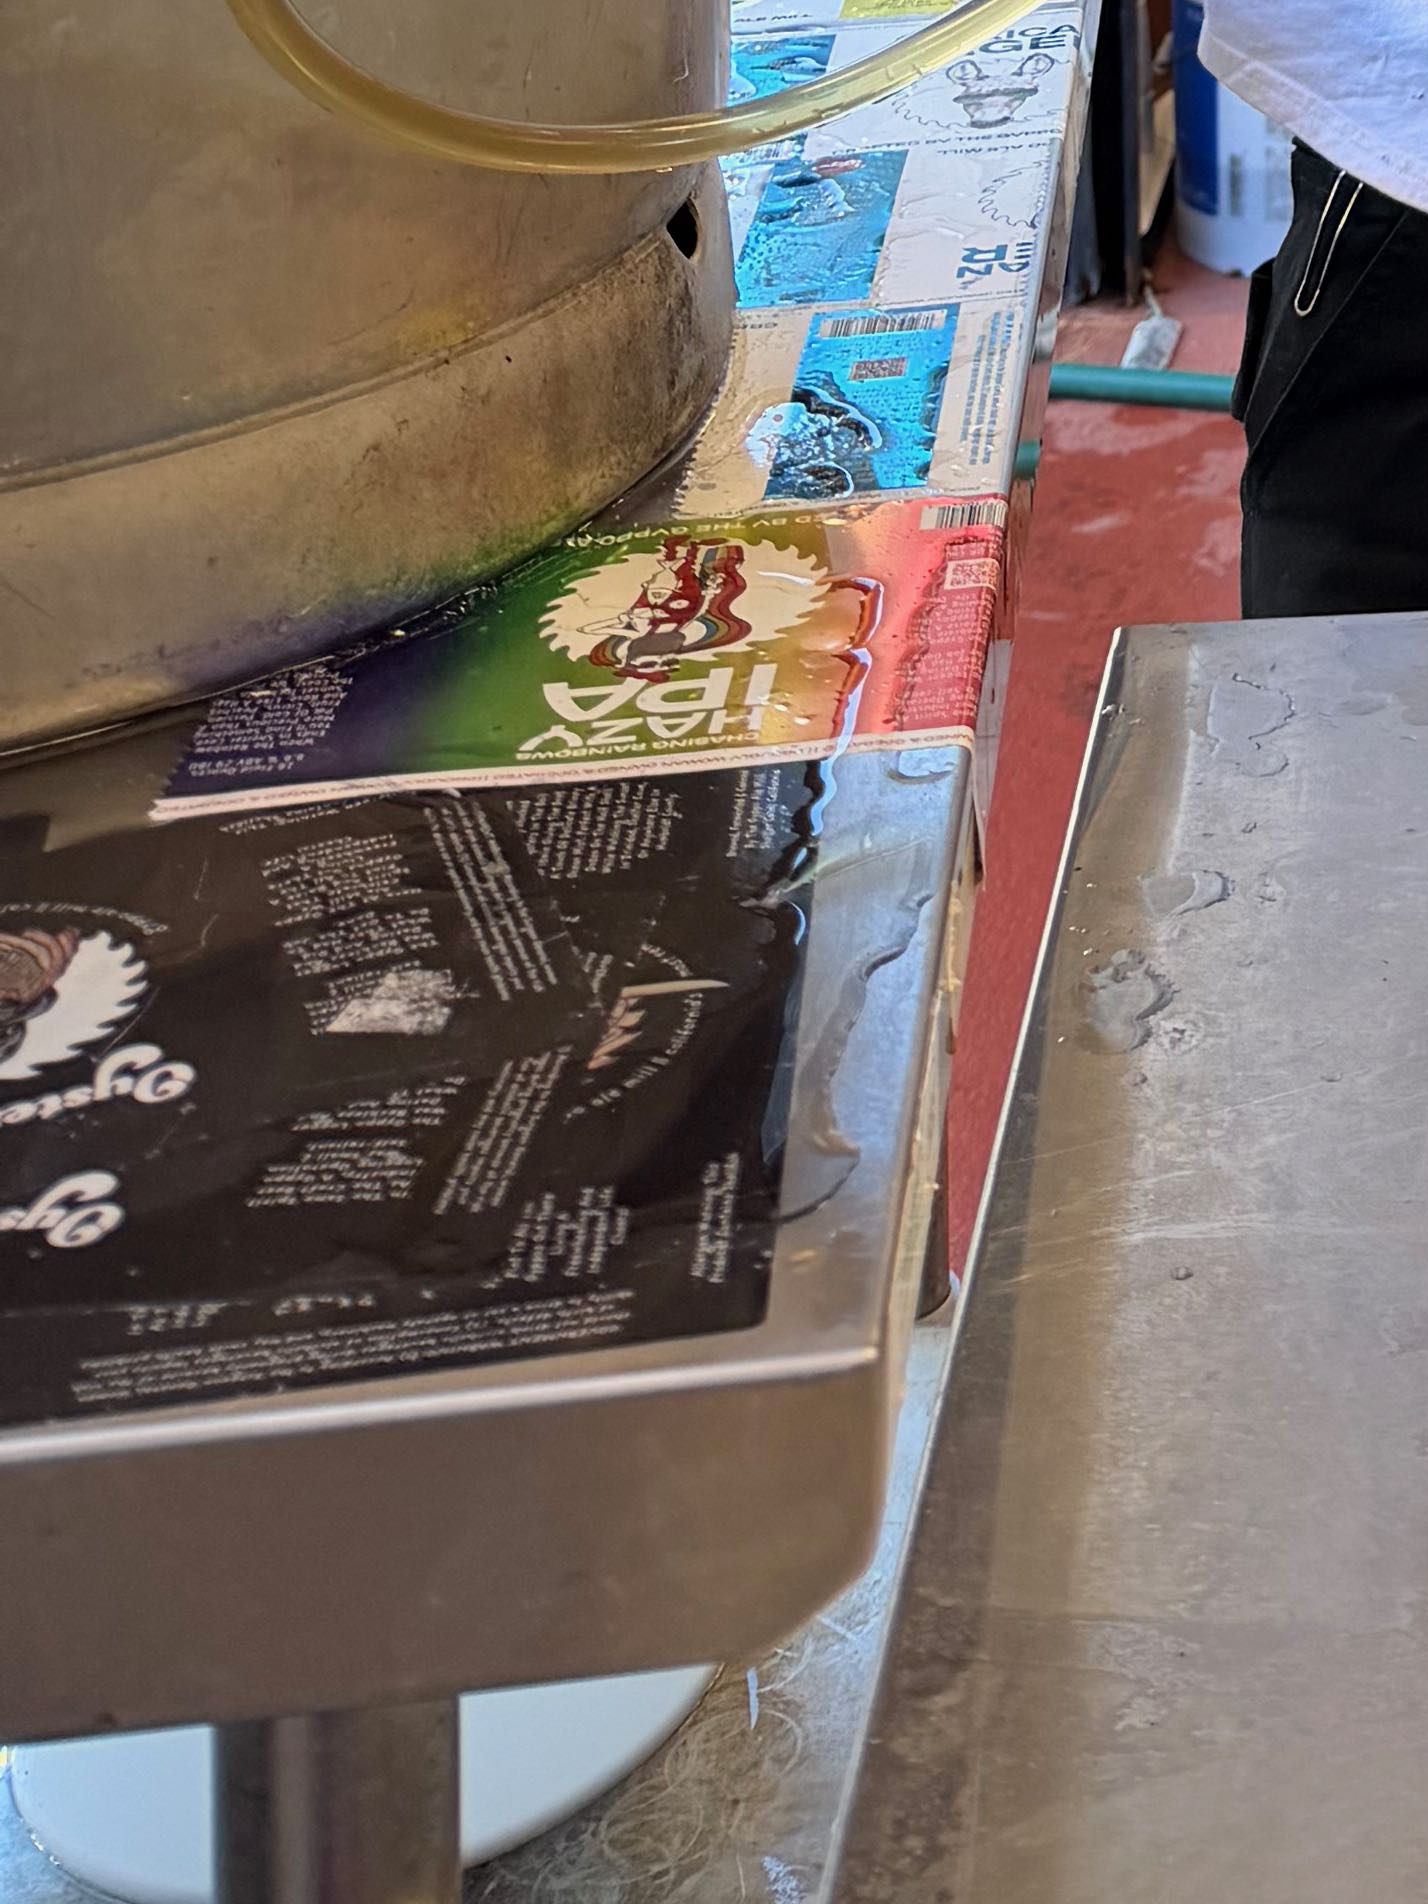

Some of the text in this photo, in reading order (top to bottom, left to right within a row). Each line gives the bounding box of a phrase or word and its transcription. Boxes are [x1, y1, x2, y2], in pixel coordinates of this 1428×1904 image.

[694, 521, 745, 533] THE
[541, 663, 778, 722] IPA
[514, 730, 759, 762] CHASING RAINBOWS
[518, 706, 766, 752] HAZY
